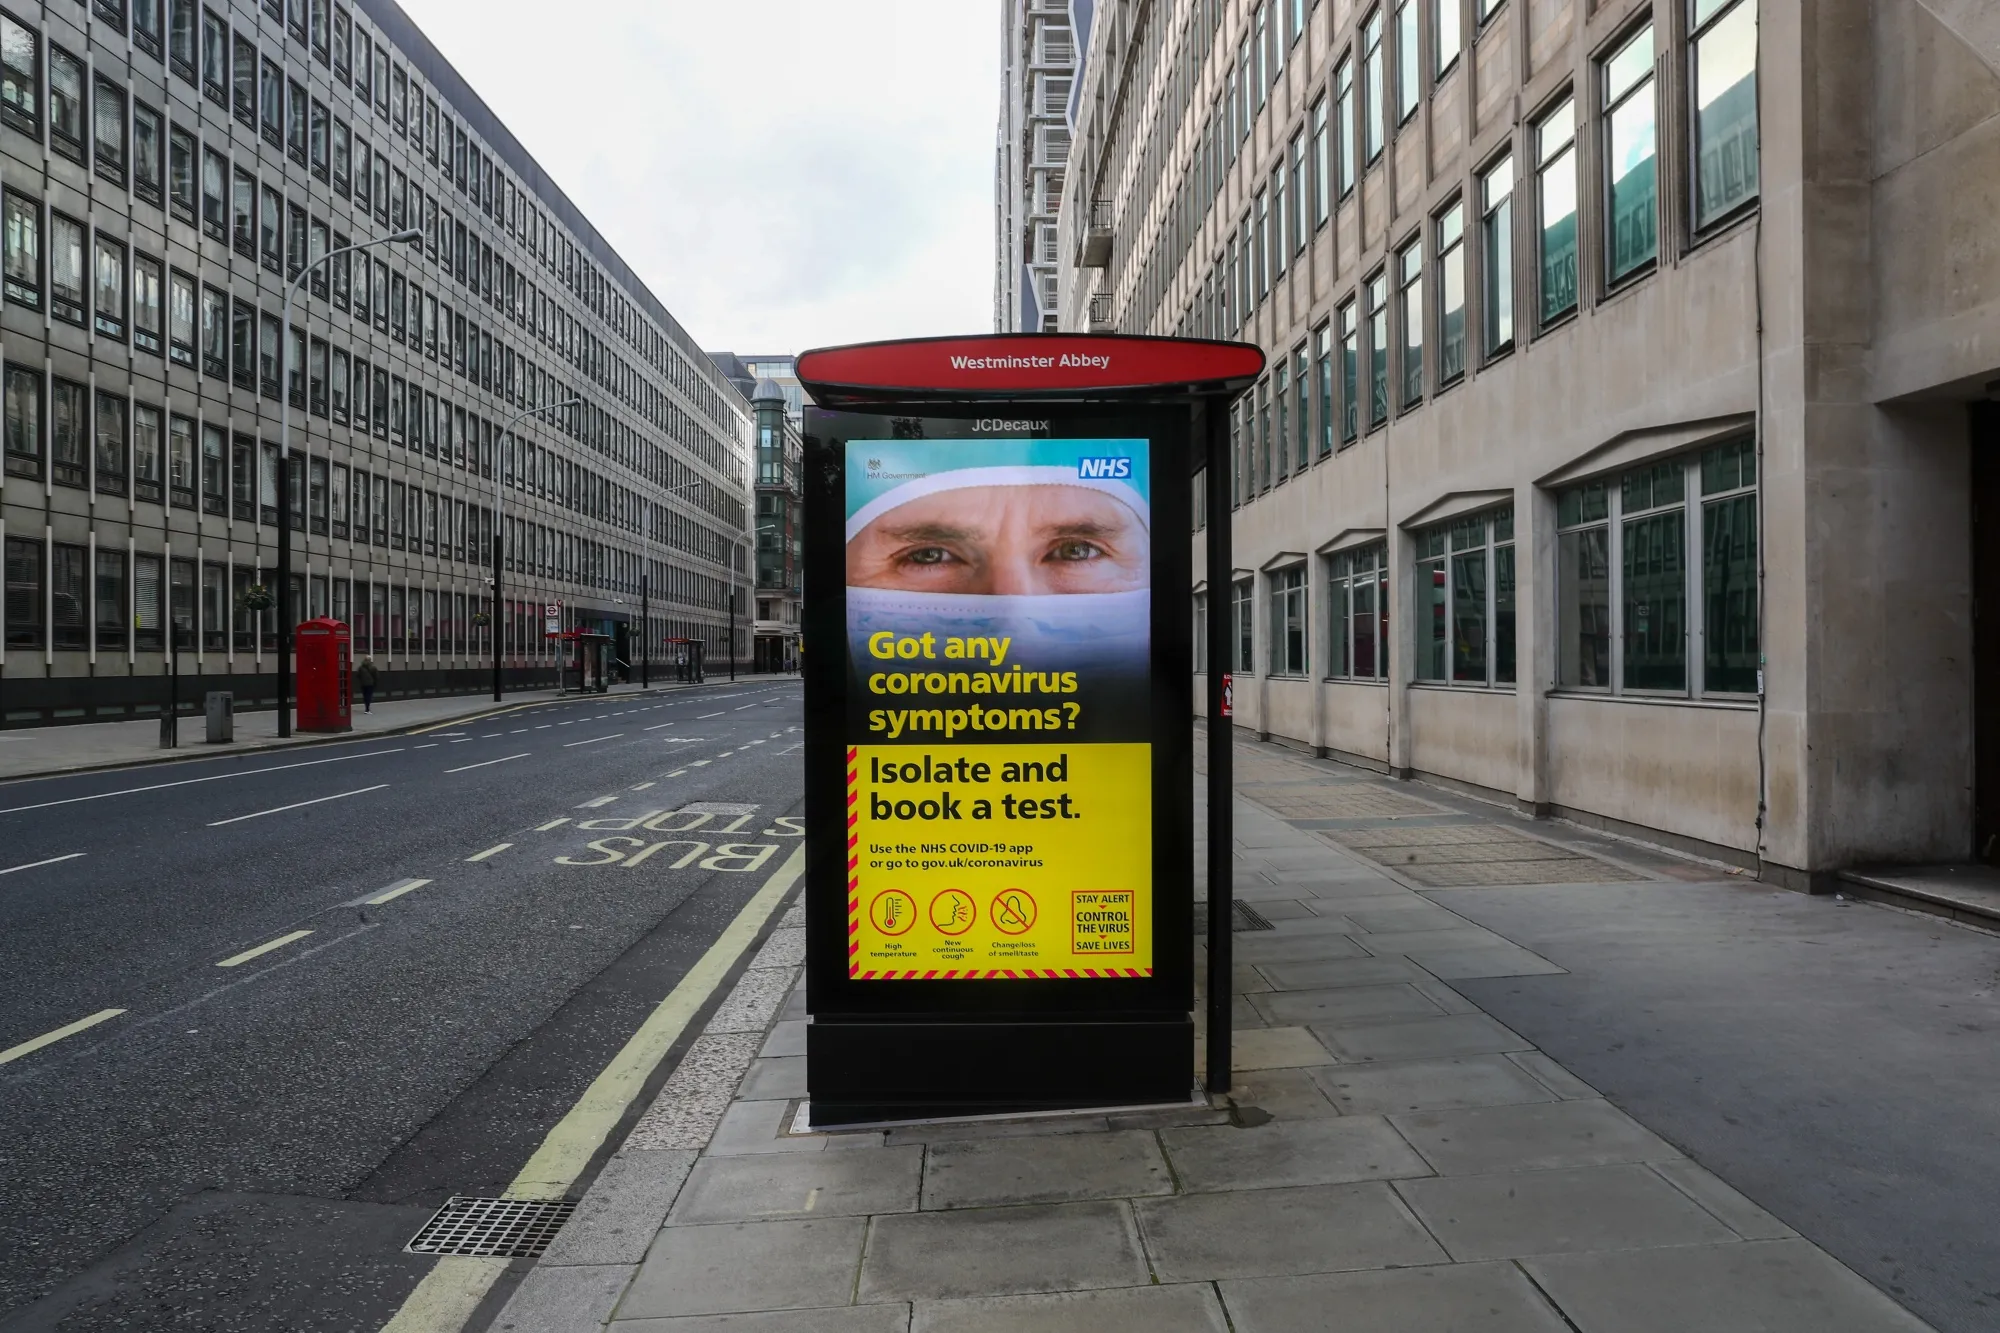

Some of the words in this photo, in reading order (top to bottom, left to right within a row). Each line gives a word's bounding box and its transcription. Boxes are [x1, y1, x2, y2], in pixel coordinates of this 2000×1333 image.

[950, 355, 1054, 370] Westminster
[1059, 353, 1110, 369] Abbey
[971, 418, 1049, 432] JCDecaux
[881, 472, 927, 480] Government
[1079, 458, 1130, 477] NHS
[868, 631, 936, 659] Got
[944, 636, 1011, 666] any
[868, 664, 1079, 695] coronavirus
[868, 701, 1081, 739] symptoms?
[870, 755, 991, 783] Isolate
[1001, 753, 1068, 783] and
[870, 791, 963, 820] book
[971, 799, 992, 820] a
[1001, 793, 1081, 819] test.
[576, 810, 806, 837] STOP
[553, 837, 781, 873] BUS
[869, 843, 893, 854] Use
[895, 843, 917, 854] the
[920, 843, 947, 854] NHS
[949, 843, 1006, 854] COVID-19
[1008, 845, 1034, 855] app
[869, 859, 884, 868] or
[885, 860, 902, 871] go
[905, 858, 919, 868] to
[921, 857, 1044, 871] gov.uk/coronavirus
[1076, 894, 1099, 904] STAY
[1101, 894, 1130, 904] ALERT
[1076, 911, 1130, 922] CONTROL
[1076, 923, 1096, 933] THE
[1098, 923, 1130, 933] VIRUS
[1076, 941, 1100, 950] SAVE
[1103, 941, 1130, 950] LIVES
